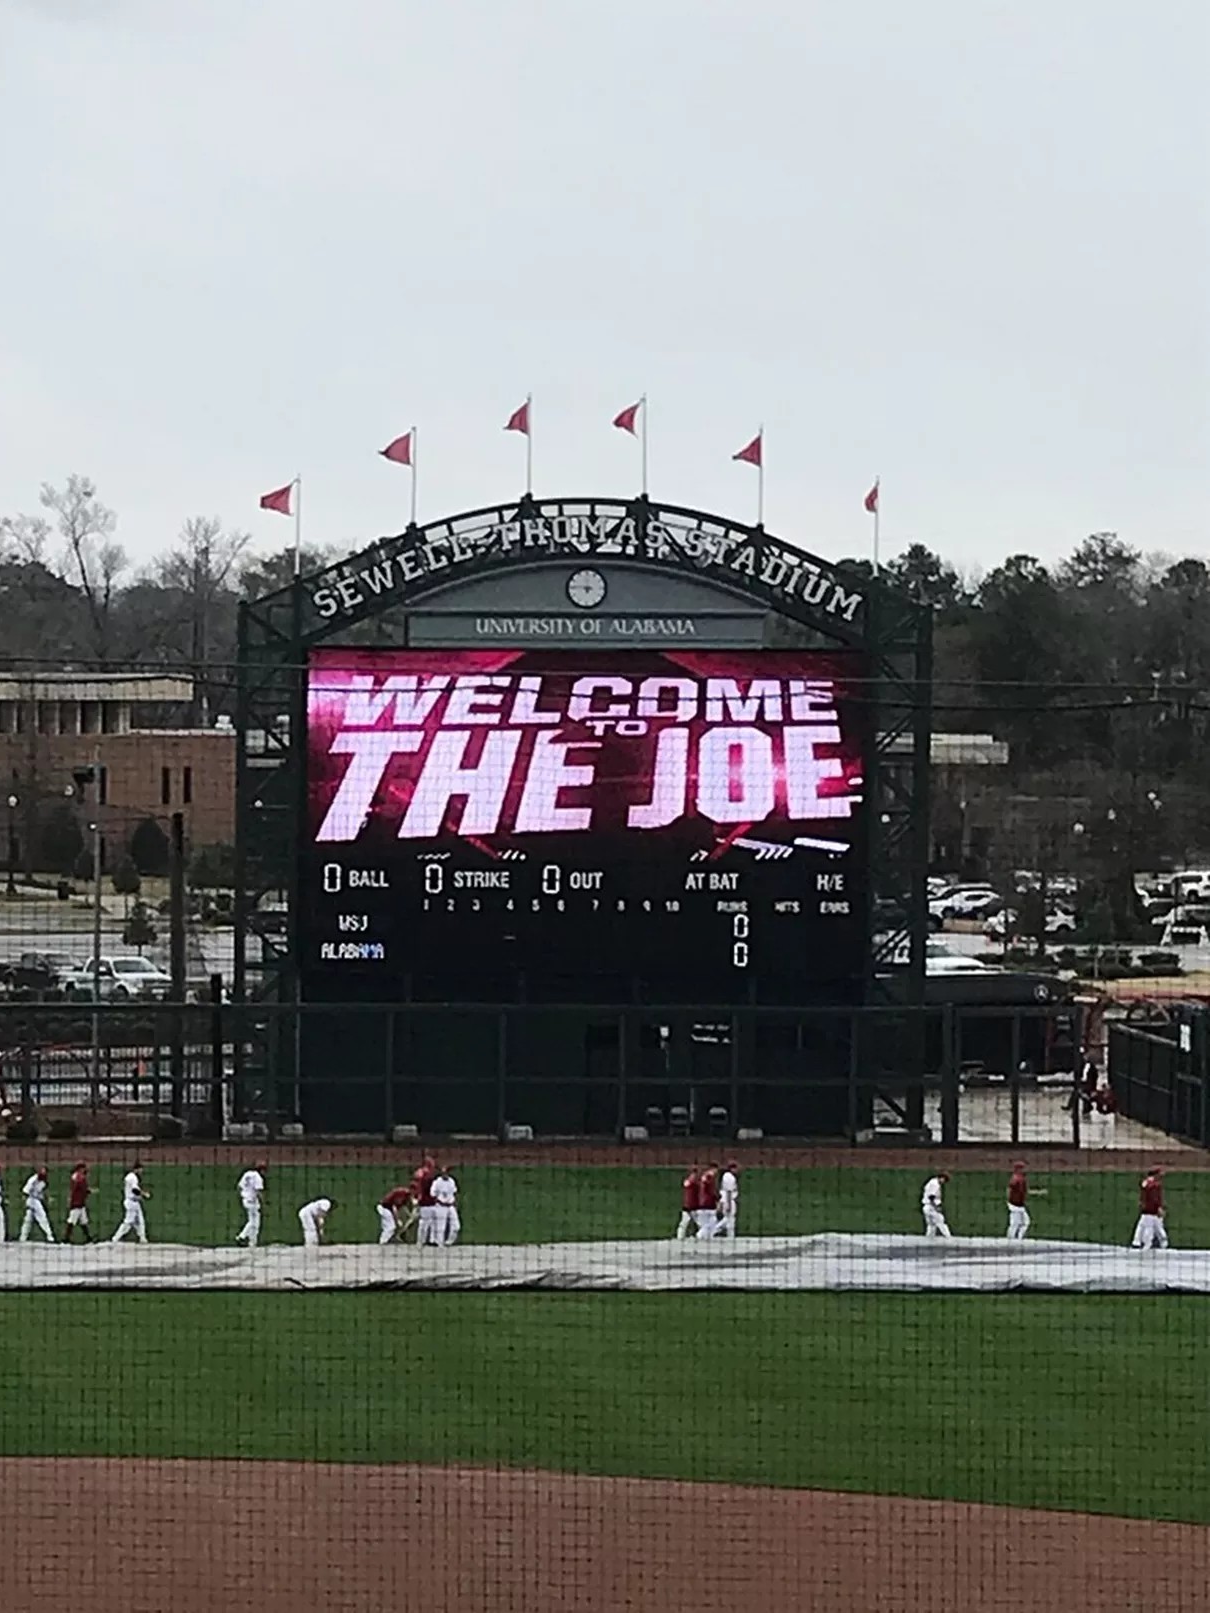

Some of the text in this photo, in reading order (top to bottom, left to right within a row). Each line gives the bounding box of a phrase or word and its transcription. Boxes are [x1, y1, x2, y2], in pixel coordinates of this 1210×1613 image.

[687, 529, 862, 621] STADIUM
[476, 618, 695, 635] UNIVERSITY OF ALABAMA
[341, 675, 838, 726] WELCOME
[586, 720, 648, 736] TO
[315, 726, 854, 842] THE JOE
[324, 863, 390, 892] 0 BALL
[425, 863, 510, 893] 0 STRIKE
[542, 865, 603, 894] 0 OUT
[685, 873, 739, 890] AT BAT
[817, 874, 844, 891] H/E
[423, 899, 680, 913] 1 2 3 4 5 6 7 8 9 10
